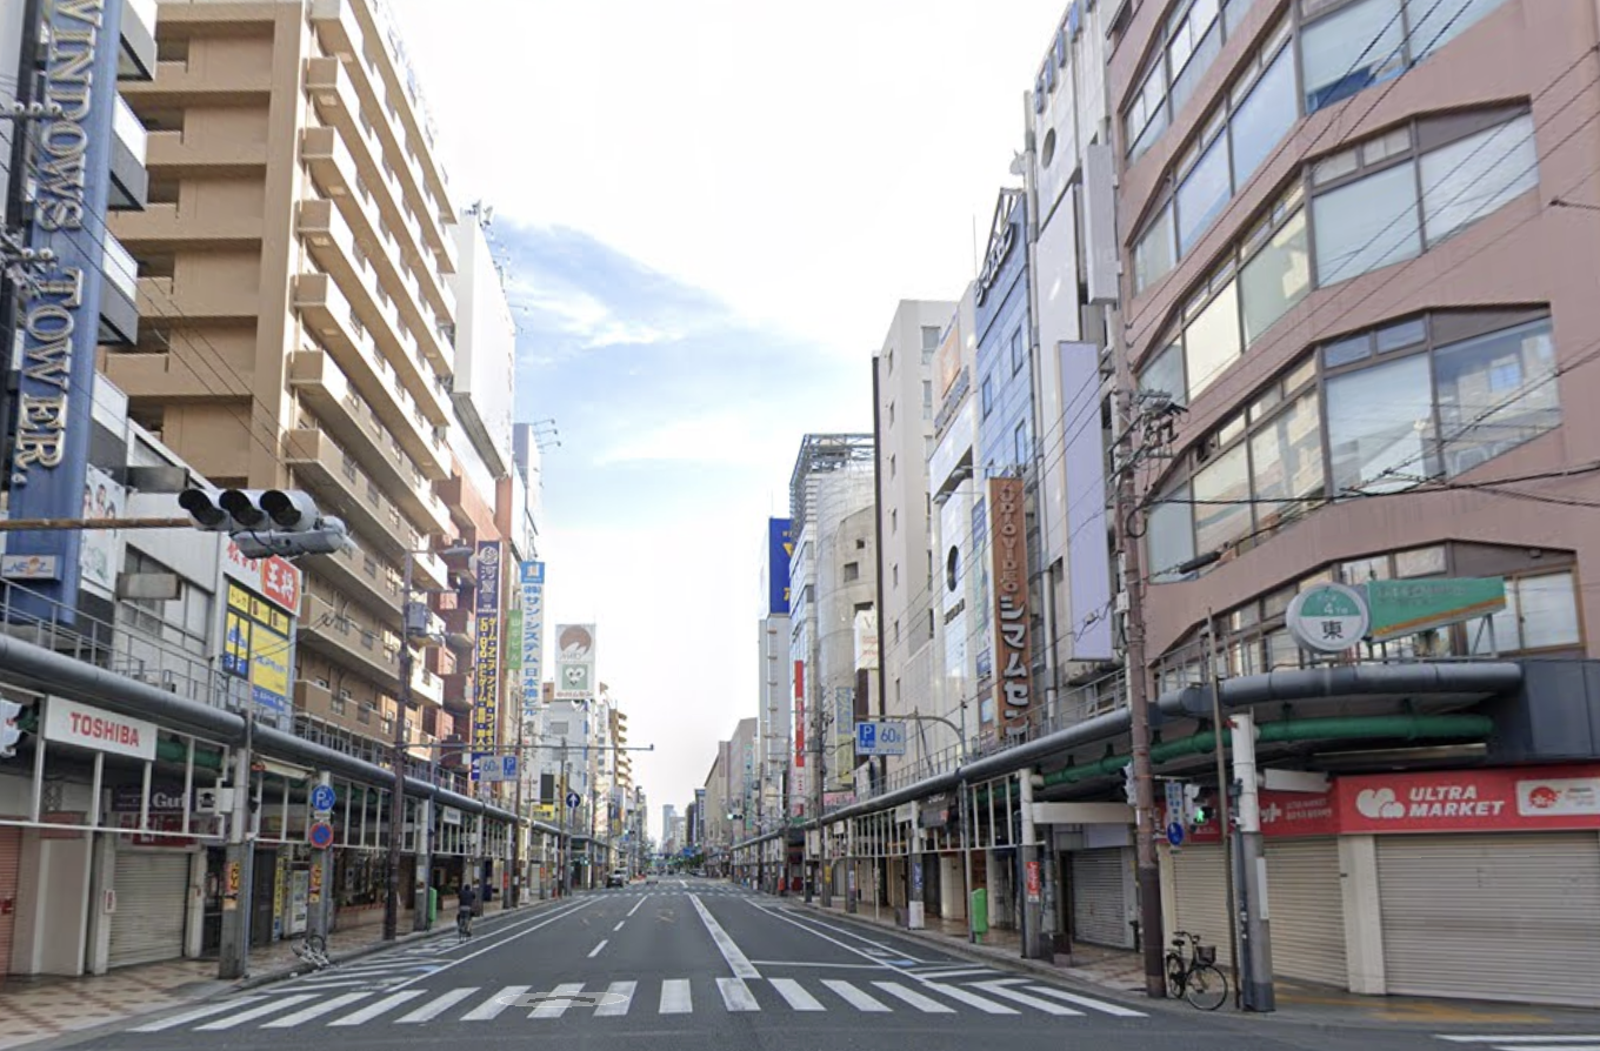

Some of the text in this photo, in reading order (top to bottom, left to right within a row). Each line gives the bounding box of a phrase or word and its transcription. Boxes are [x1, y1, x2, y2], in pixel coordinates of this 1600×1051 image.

[267, 563, 294, 603] 王将
[1321, 620, 1344, 640] 東
[1000, 595, 1029, 737] シマムセン
[68, 711, 139, 747] TOSHIBA
[863, 725, 873, 739] P
[315, 791, 326, 806] P
[1409, 785, 1478, 801] ULTRA
[1408, 800, 1505, 818] MARKET
